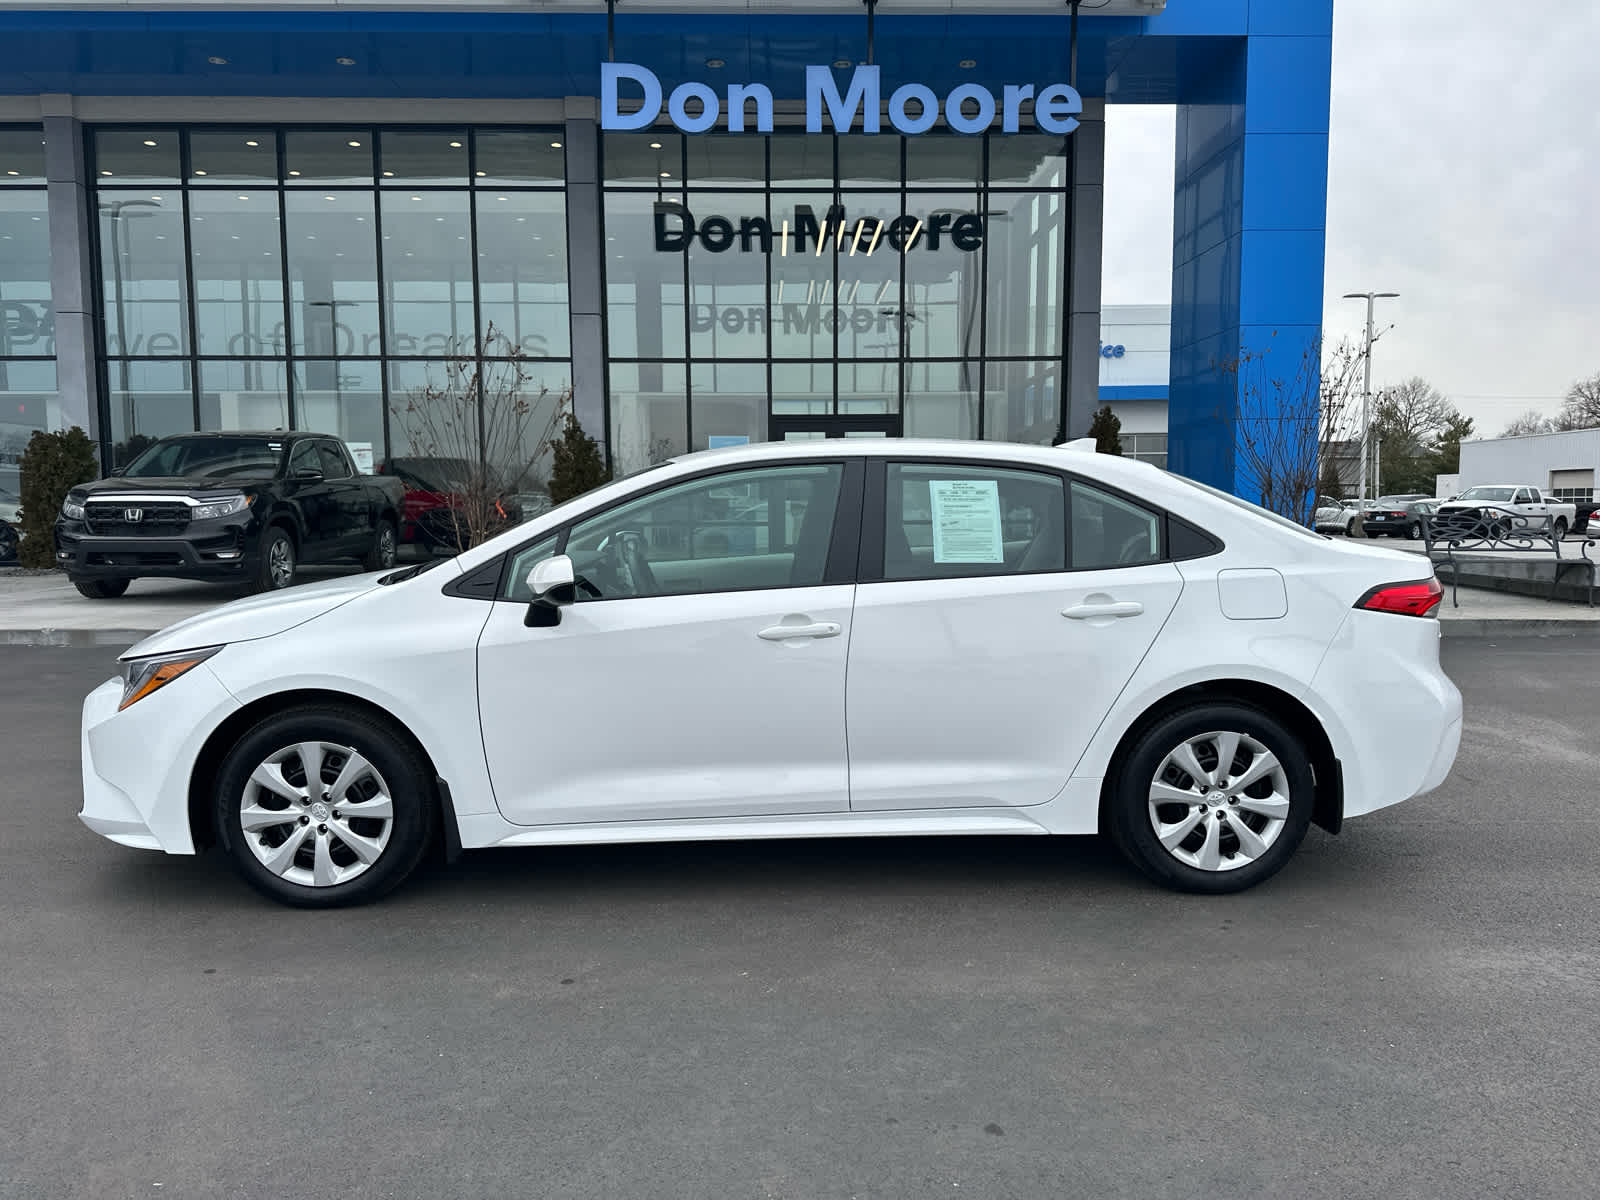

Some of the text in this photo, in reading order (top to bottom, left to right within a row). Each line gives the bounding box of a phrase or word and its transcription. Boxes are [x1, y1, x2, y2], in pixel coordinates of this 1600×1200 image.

[601, 62, 1083, 135] Don Moore
[653, 200, 984, 253] Don Moore
[689, 302, 768, 335] Don
